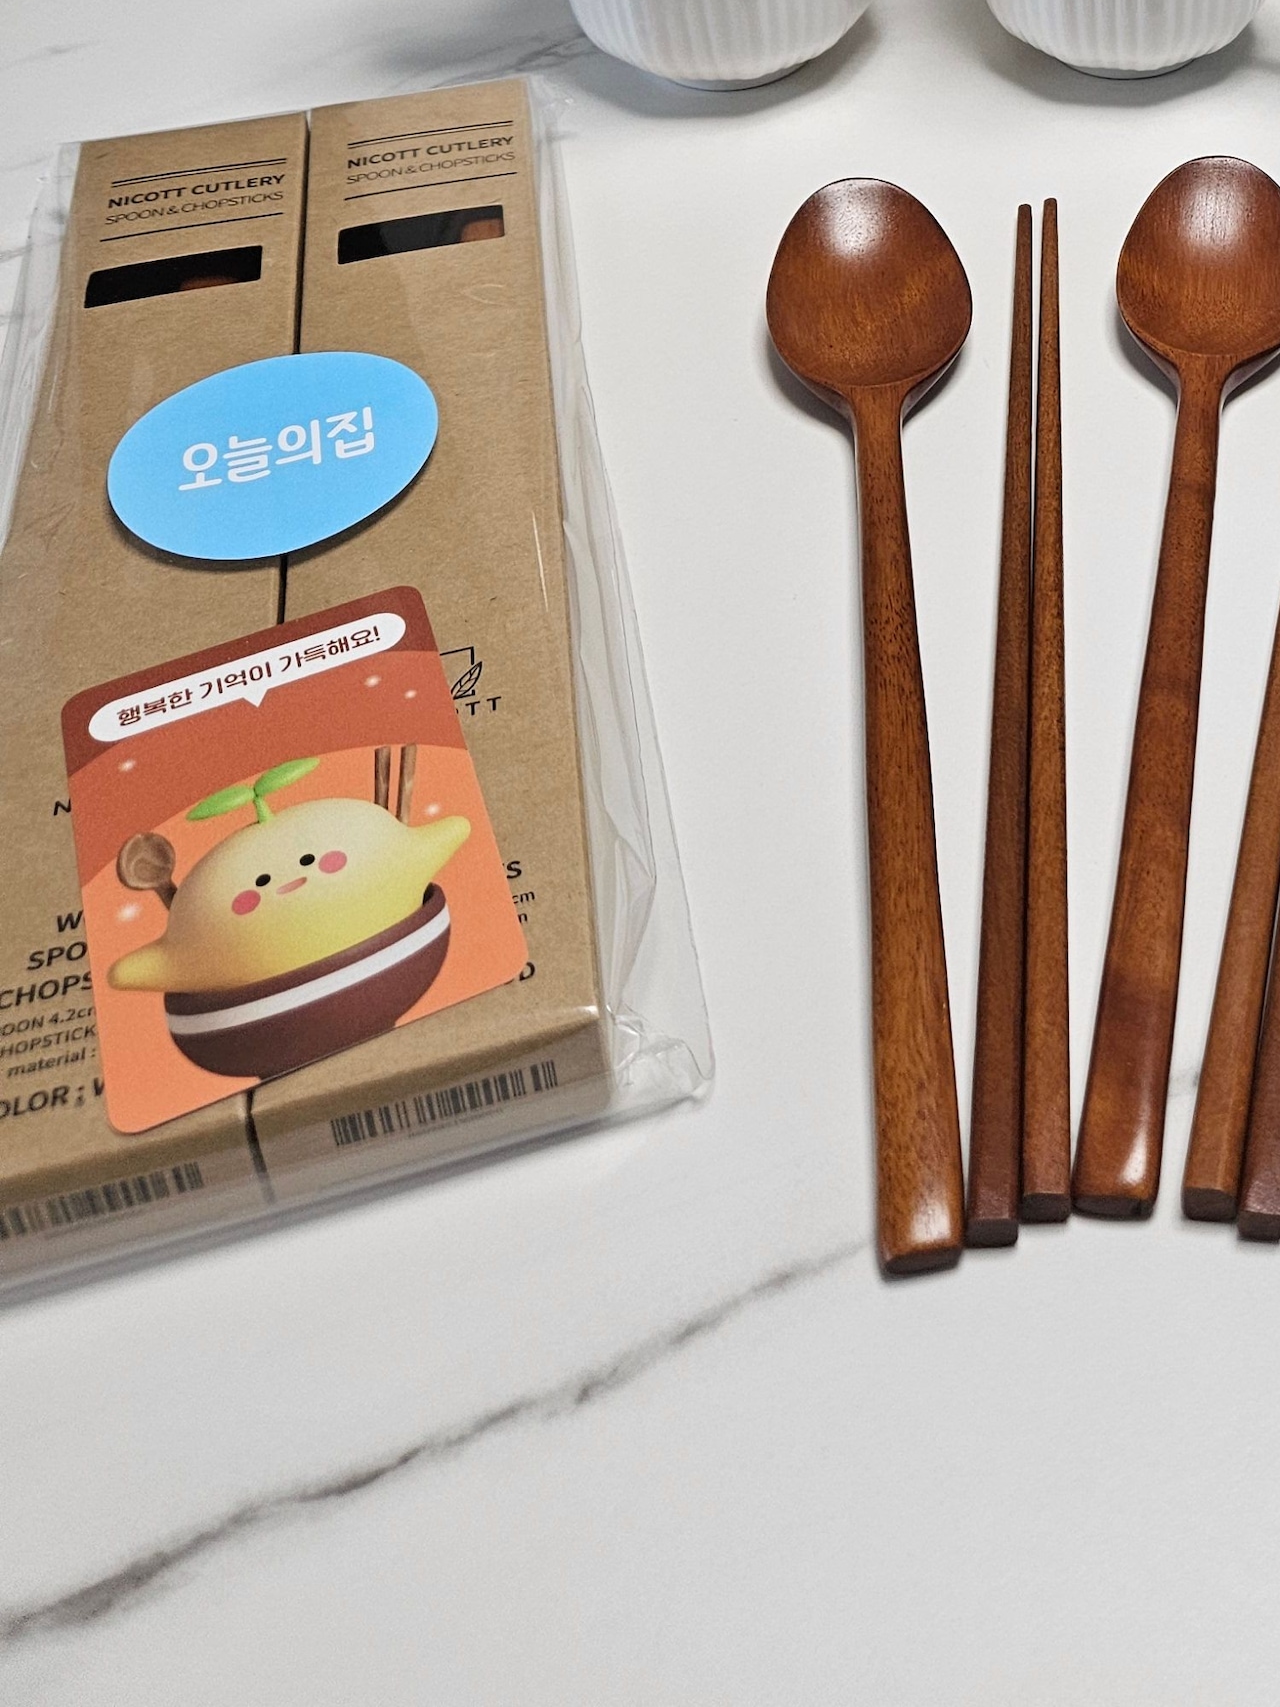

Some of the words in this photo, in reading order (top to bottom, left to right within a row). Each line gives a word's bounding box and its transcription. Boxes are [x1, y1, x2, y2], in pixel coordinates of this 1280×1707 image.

[347, 147, 421, 169] NICOTT
[426, 136, 514, 156] CUTLERY
[108, 187, 187, 209] NICOTT
[191, 174, 286, 195] CUTLERY
[178, 406, 375, 491] 오늘의집
[116, 688, 193, 727] 행복한
[199, 661, 272, 699] 기억이
[279, 626, 381, 672] 가득해요!
[26, 941, 88, 971] SPO
[0, 971, 92, 1010] CHOPS
